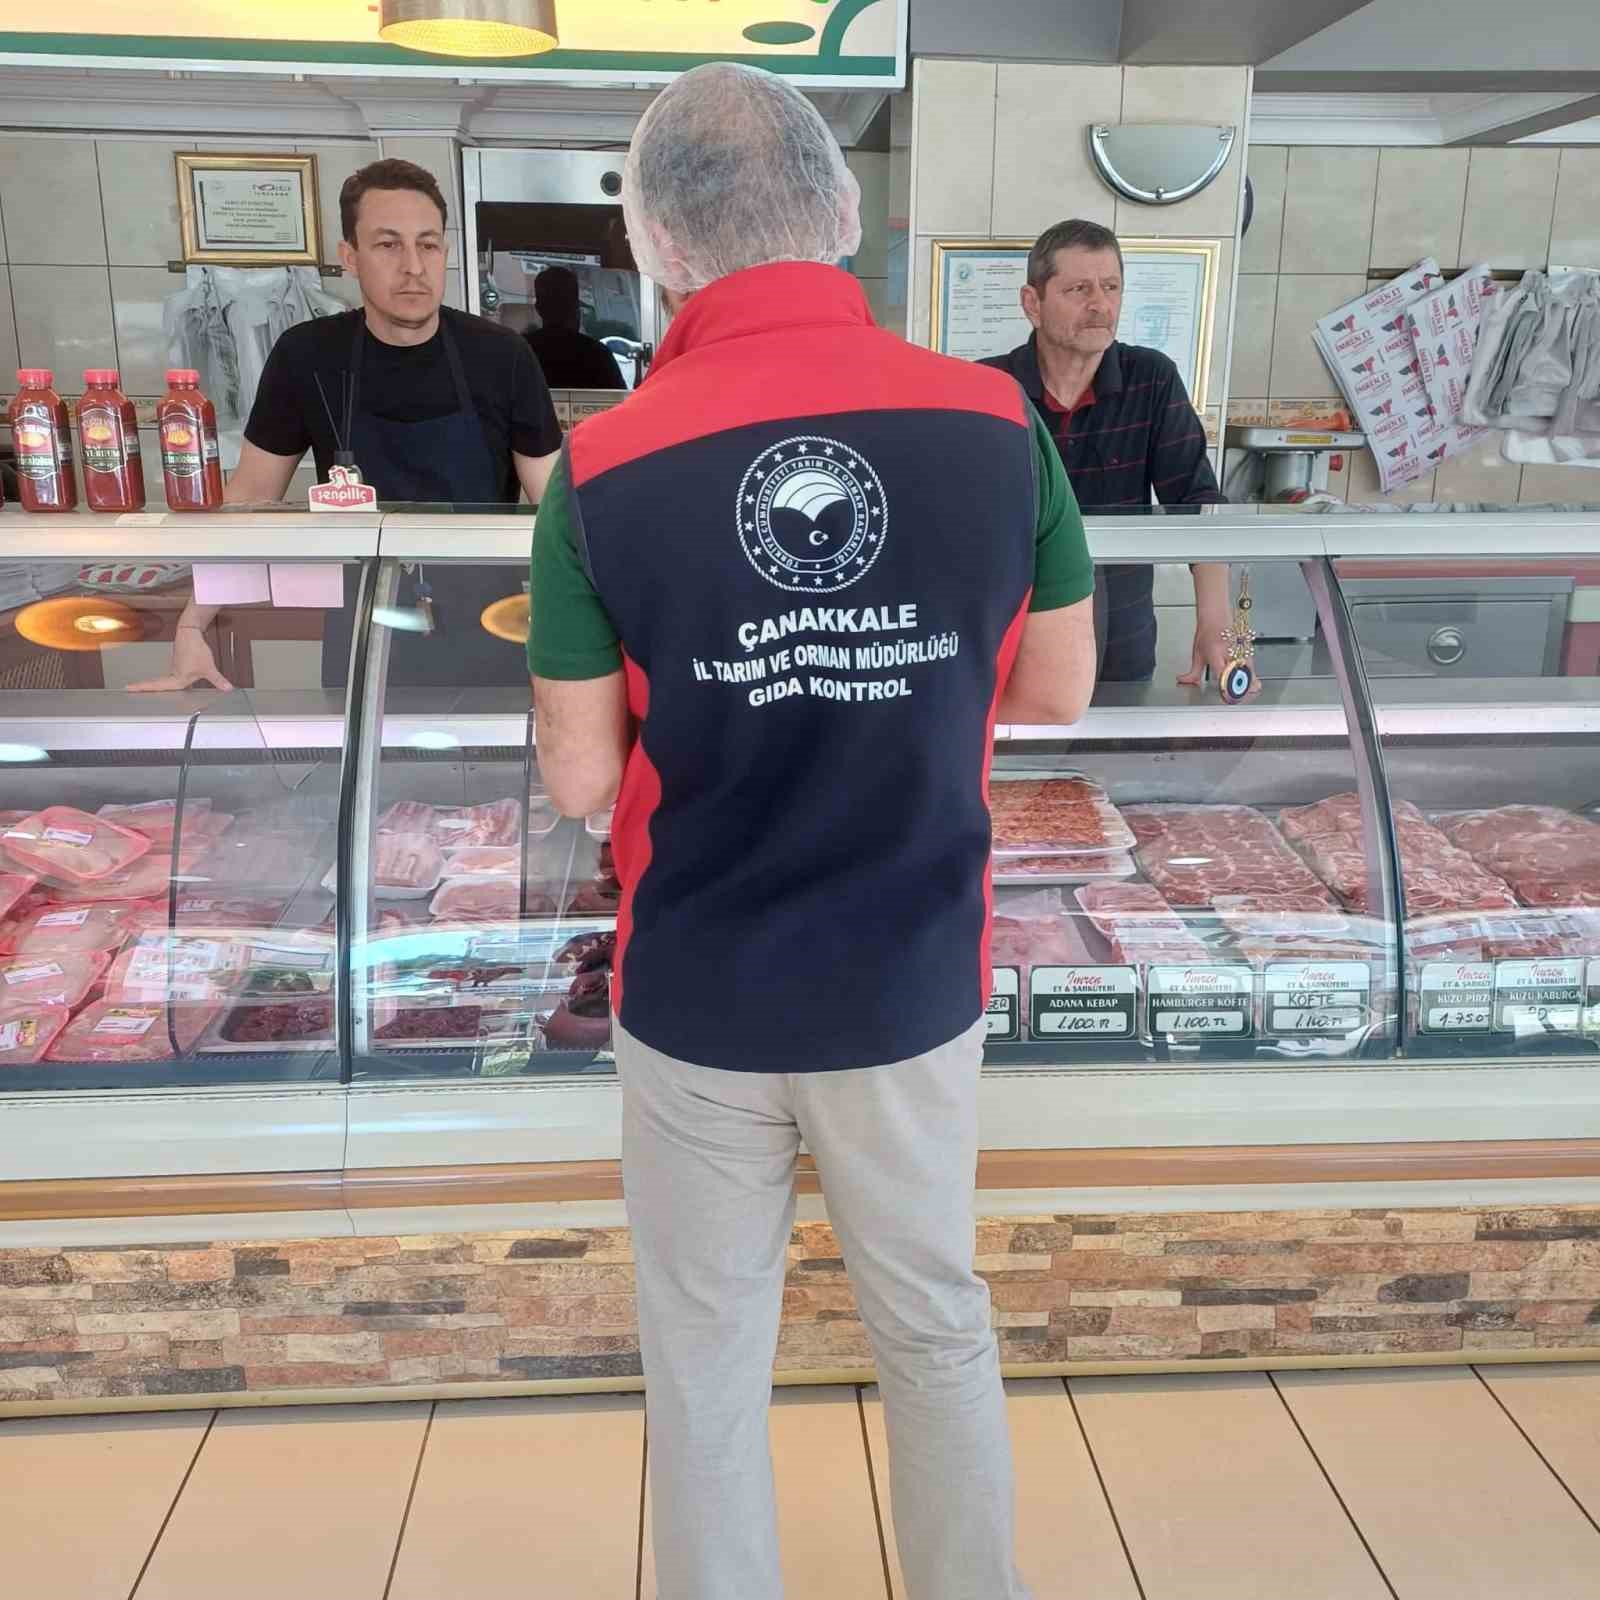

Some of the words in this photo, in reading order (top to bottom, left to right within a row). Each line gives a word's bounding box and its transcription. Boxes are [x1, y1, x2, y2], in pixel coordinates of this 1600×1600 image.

[792, 460, 823, 469] TARIM
[828, 462, 839, 474] VE
[738, 604, 917, 652] ÇANAKKALE
[693, 658, 712, 681] İL
[713, 659, 766, 683] TARIM
[769, 649, 791, 674] VE
[794, 645, 850, 669] ORMAN
[856, 632, 959, 670] MÜDÜRLÜĞÜ
[749, 677, 803, 707] GIDA
[809, 676, 912, 701] KONTROL
[1438, 994, 1462, 1003] KUZU
[1510, 992, 1534, 1000] KUZU
[1537, 990, 1582, 1000] KABURGA
[1050, 999, 1083, 1008] ADANA
[1086, 999, 1119, 1008] KEBAP
[1152, 998, 1215, 1008] HAMBURGER
